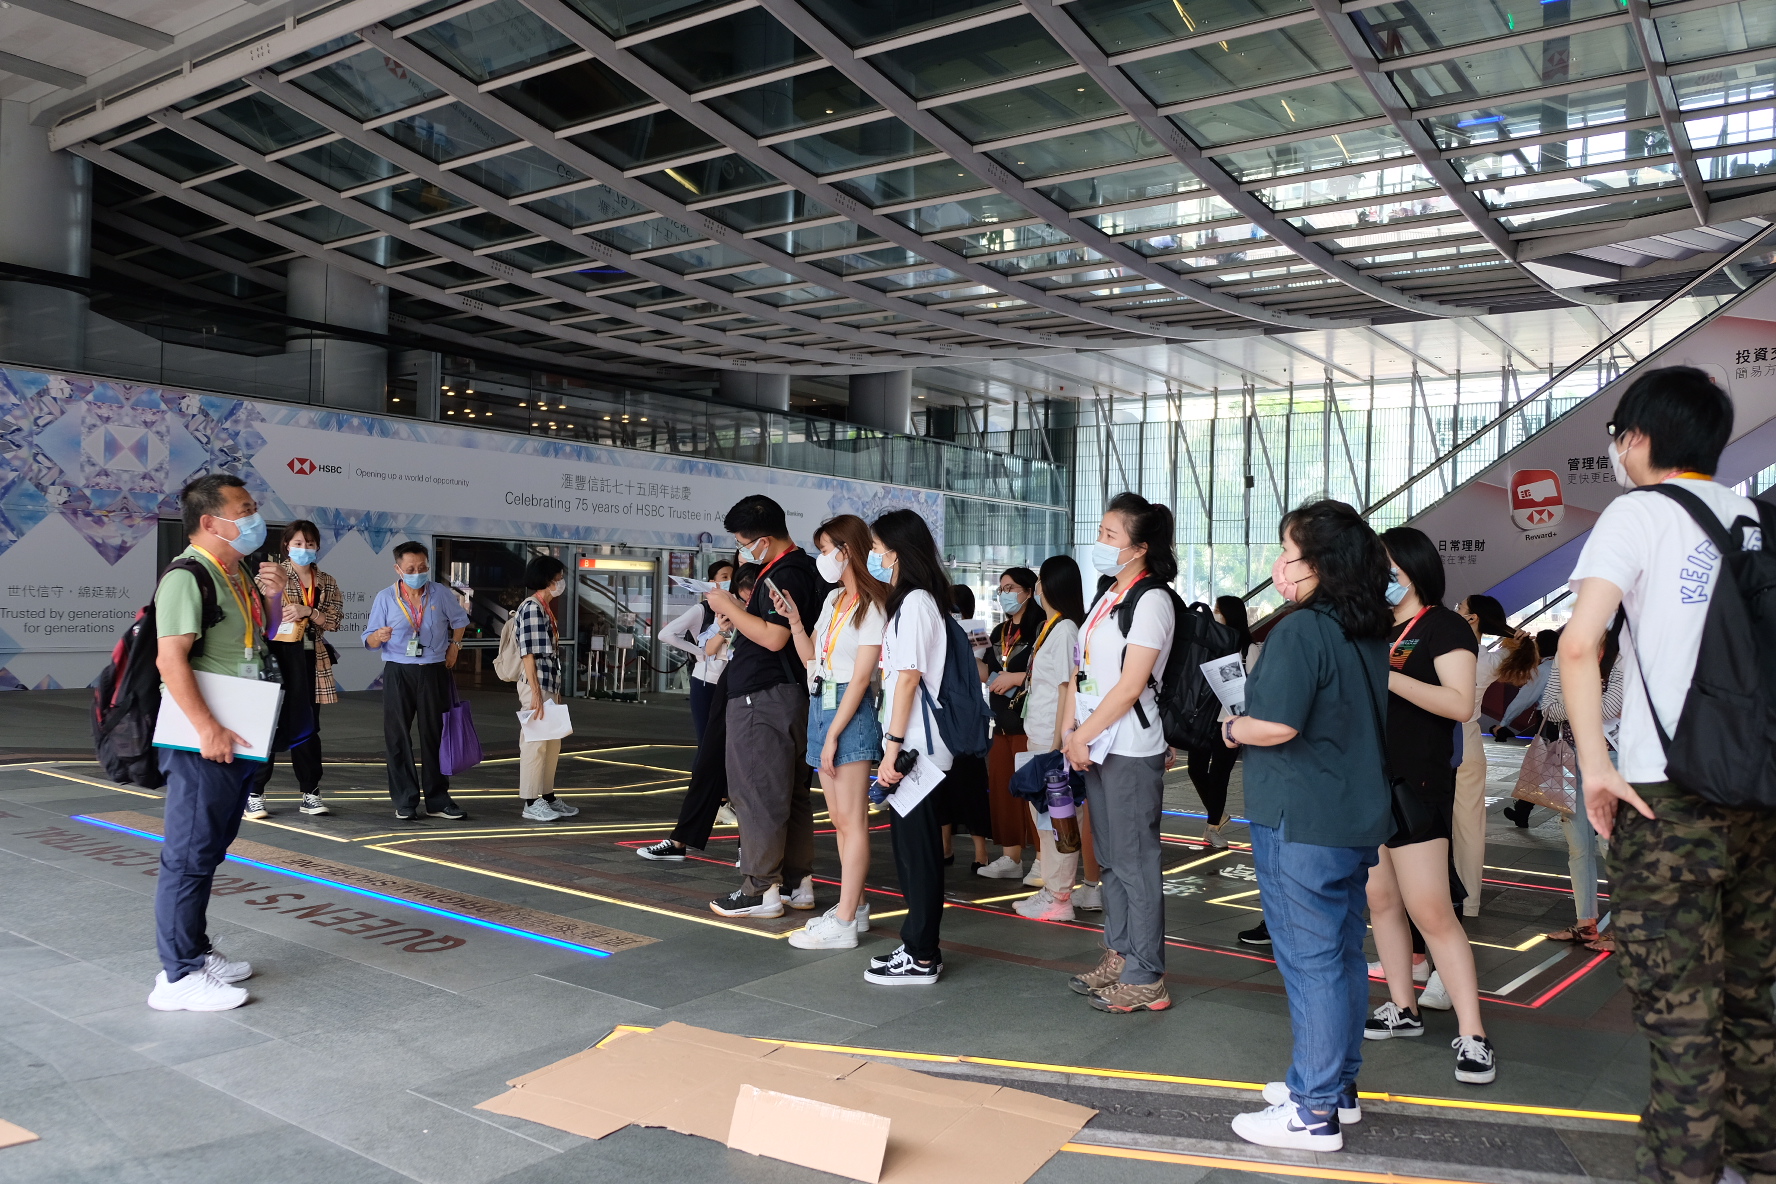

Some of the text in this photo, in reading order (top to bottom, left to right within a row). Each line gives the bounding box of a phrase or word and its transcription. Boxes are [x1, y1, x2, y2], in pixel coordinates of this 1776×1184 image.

[318, 464, 343, 475] HSBC
[1567, 455, 1614, 472] 管理信
[355, 467, 386, 481] Opening
[387, 472, 398, 481] up
[404, 473, 424, 483] world
[425, 475, 432, 483] of
[433, 476, 470, 488] opportunity
[1567, 472, 1617, 485] 更快更Ea
[504, 491, 728, 523] Celebrating 75 years of HSBC Trustee in As
[1525, 531, 1558, 541] Reward+
[1438, 539, 1486, 552] 日常理財
[0, 607, 137, 621] Trusted by generations
[23, 622, 115, 635] for generations
[339, 622, 360, 632] ealth
[11, 826, 160, 867] CENTRAL
[282, 858, 503, 915] ORIGINAL SHORELINE
[244, 893, 467, 954] QUEEN'S
